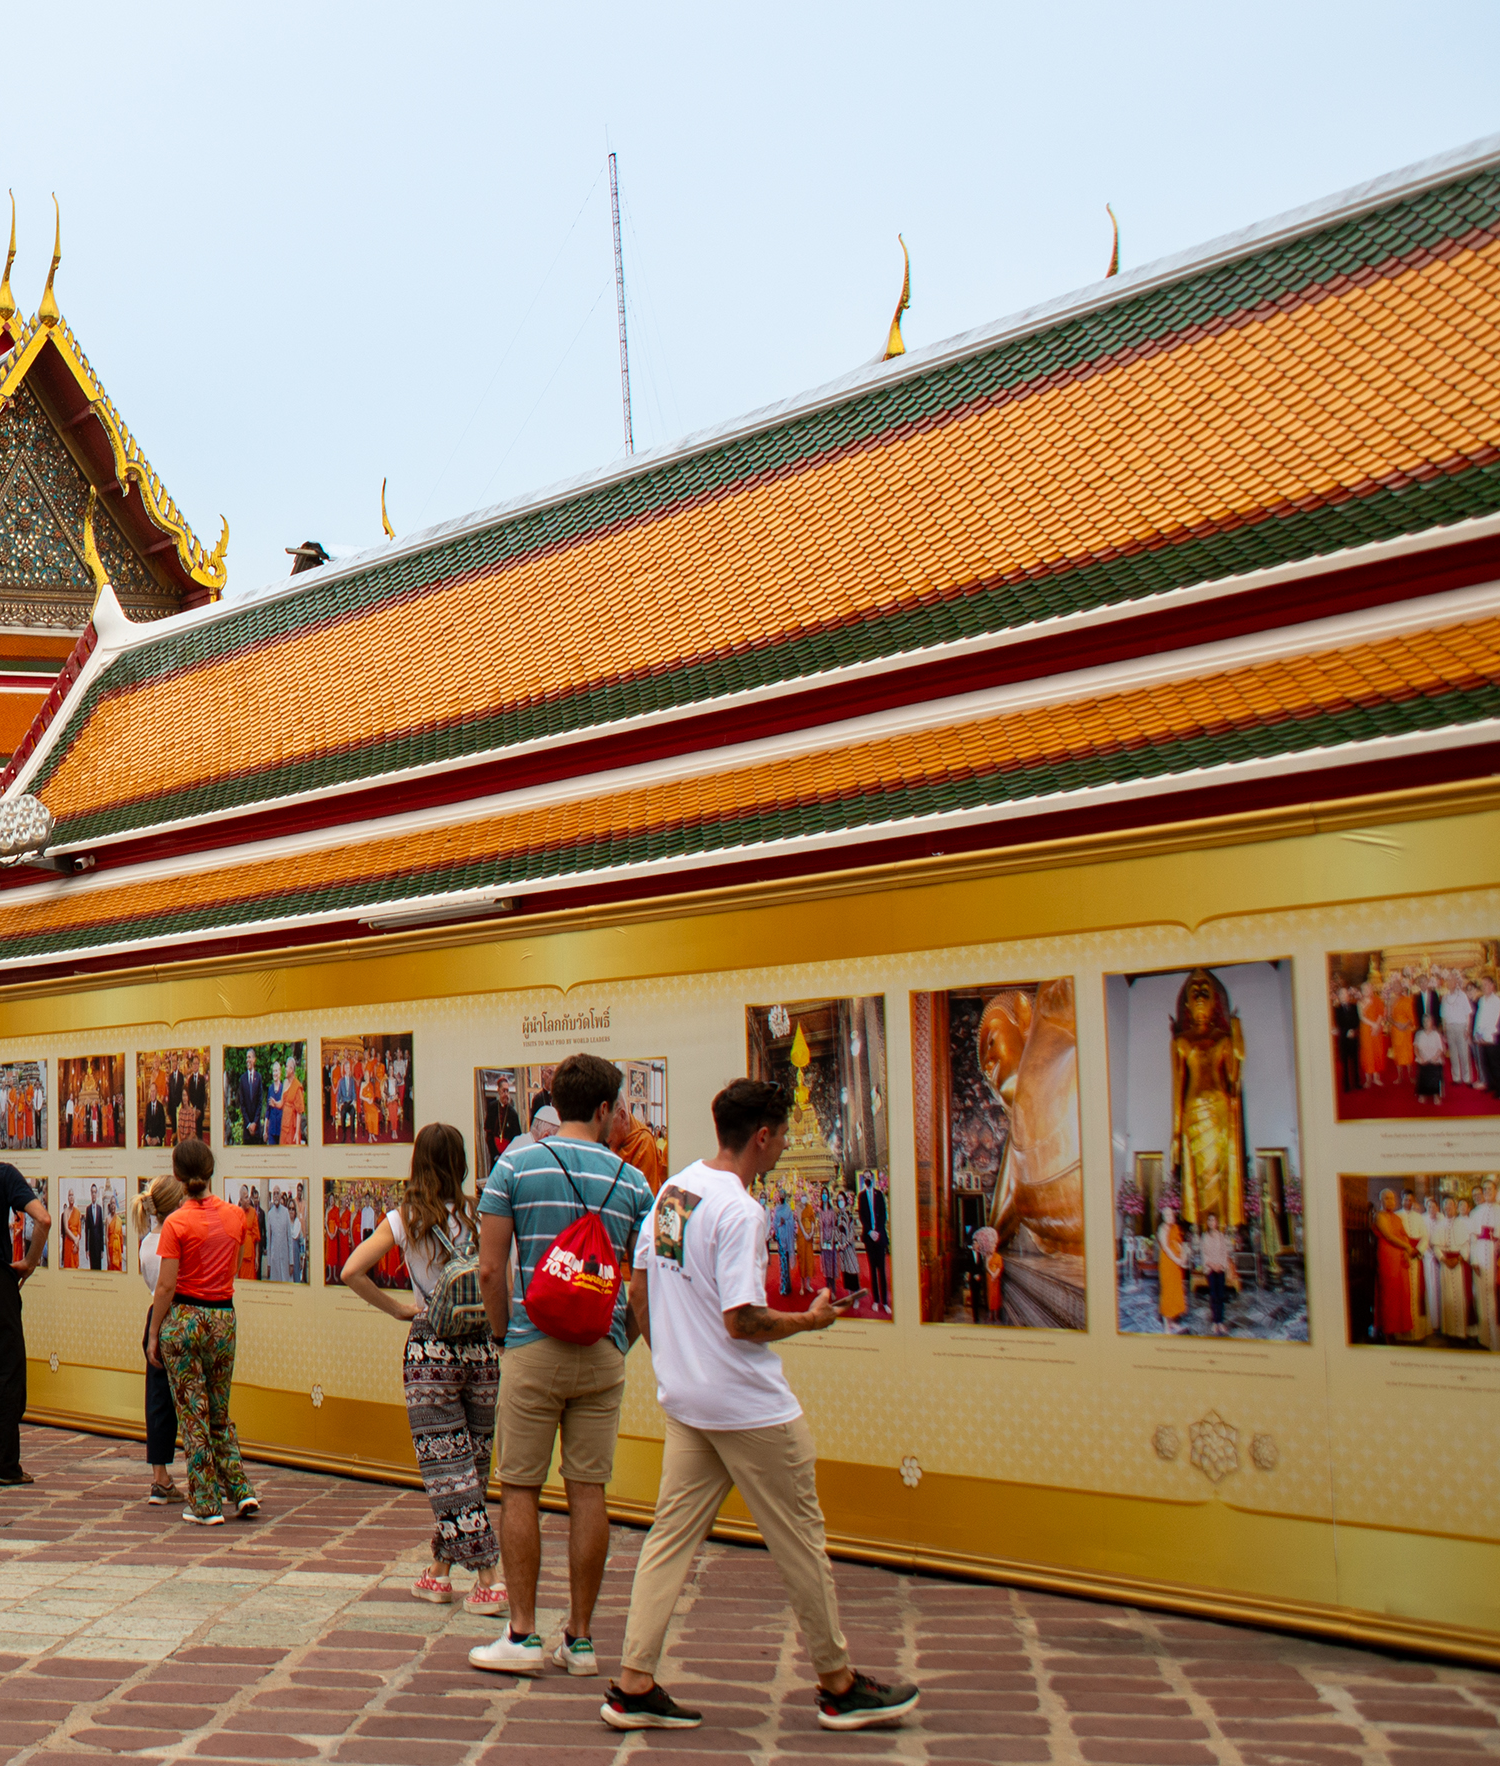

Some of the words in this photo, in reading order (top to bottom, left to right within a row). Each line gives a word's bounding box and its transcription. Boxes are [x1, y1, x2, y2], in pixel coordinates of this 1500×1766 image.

[522, 1005, 611, 1039] ผู้นำโลกกับวัดโพธิ์
